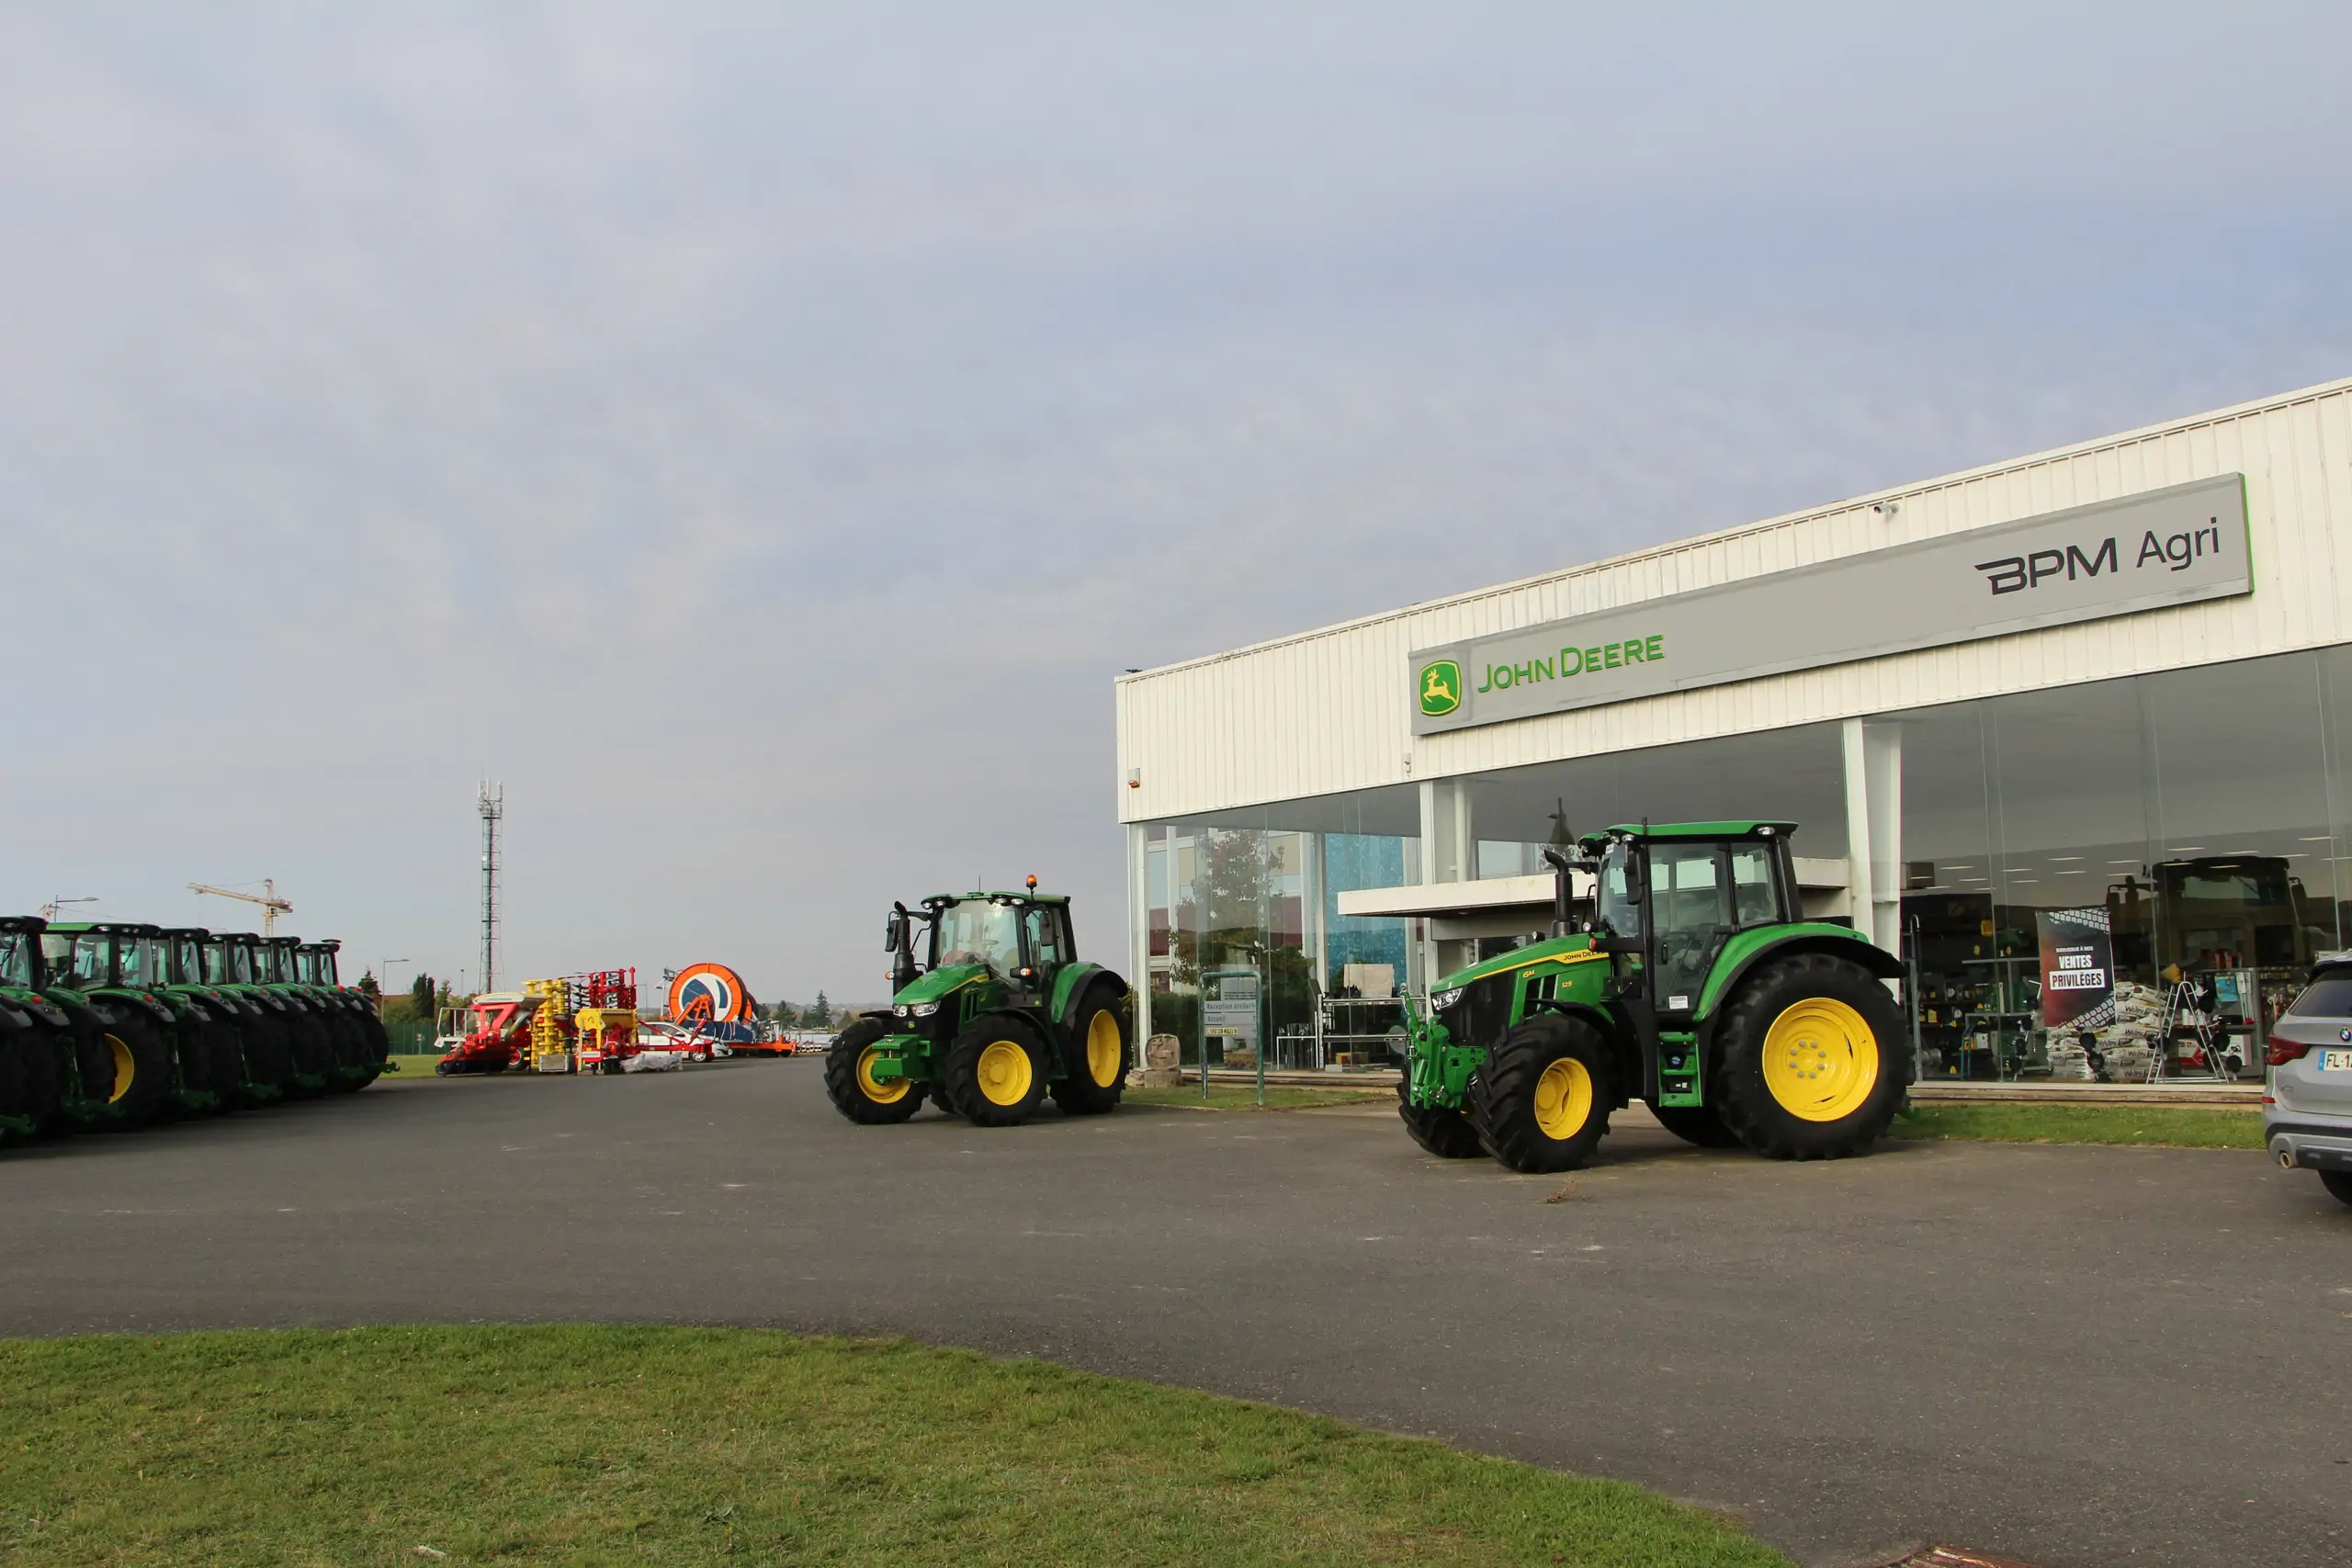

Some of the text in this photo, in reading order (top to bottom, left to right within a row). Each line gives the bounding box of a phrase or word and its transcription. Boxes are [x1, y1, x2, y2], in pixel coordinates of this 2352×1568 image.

[1974, 516, 2220, 595] BPM Agri
[1477, 634, 1665, 694] JOHN DEERE
[2052, 972, 2102, 987] PRIVILÈGES
[2059, 954, 2092, 969] VENTES
